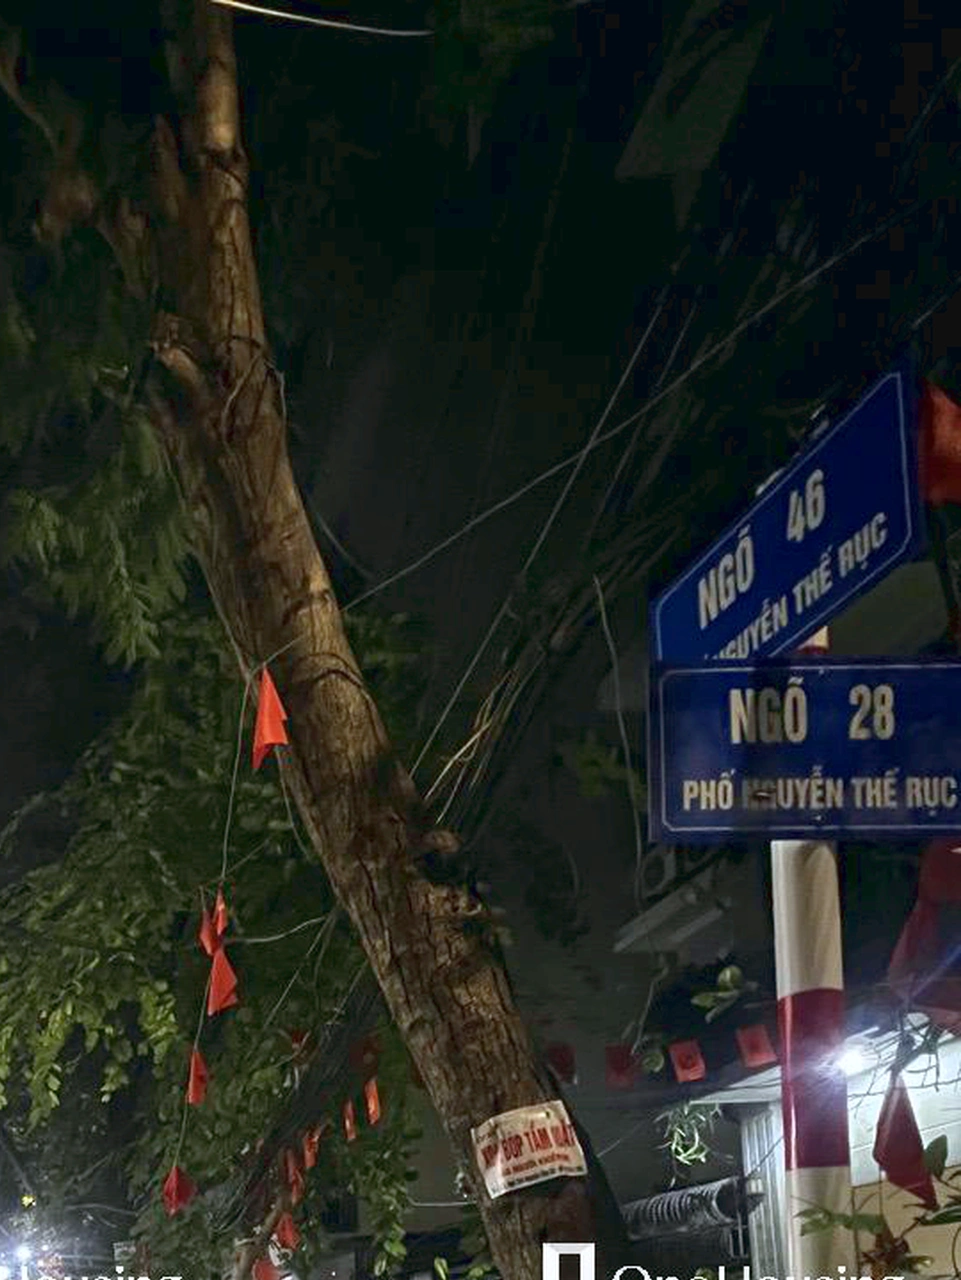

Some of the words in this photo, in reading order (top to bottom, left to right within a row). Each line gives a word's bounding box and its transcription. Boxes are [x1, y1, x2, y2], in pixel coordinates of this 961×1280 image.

[698, 524, 755, 630] NGÕ
[787, 469, 825, 542] 46
[792, 544, 833, 615] THẾ
[838, 512, 888, 579] RỤC
[729, 676, 807, 744] NGÕ
[848, 684, 895, 740] 28
[683, 768, 737, 811] PHỐ
[852, 767, 899, 809] THẾ
[906, 776, 957, 817] RỤC
